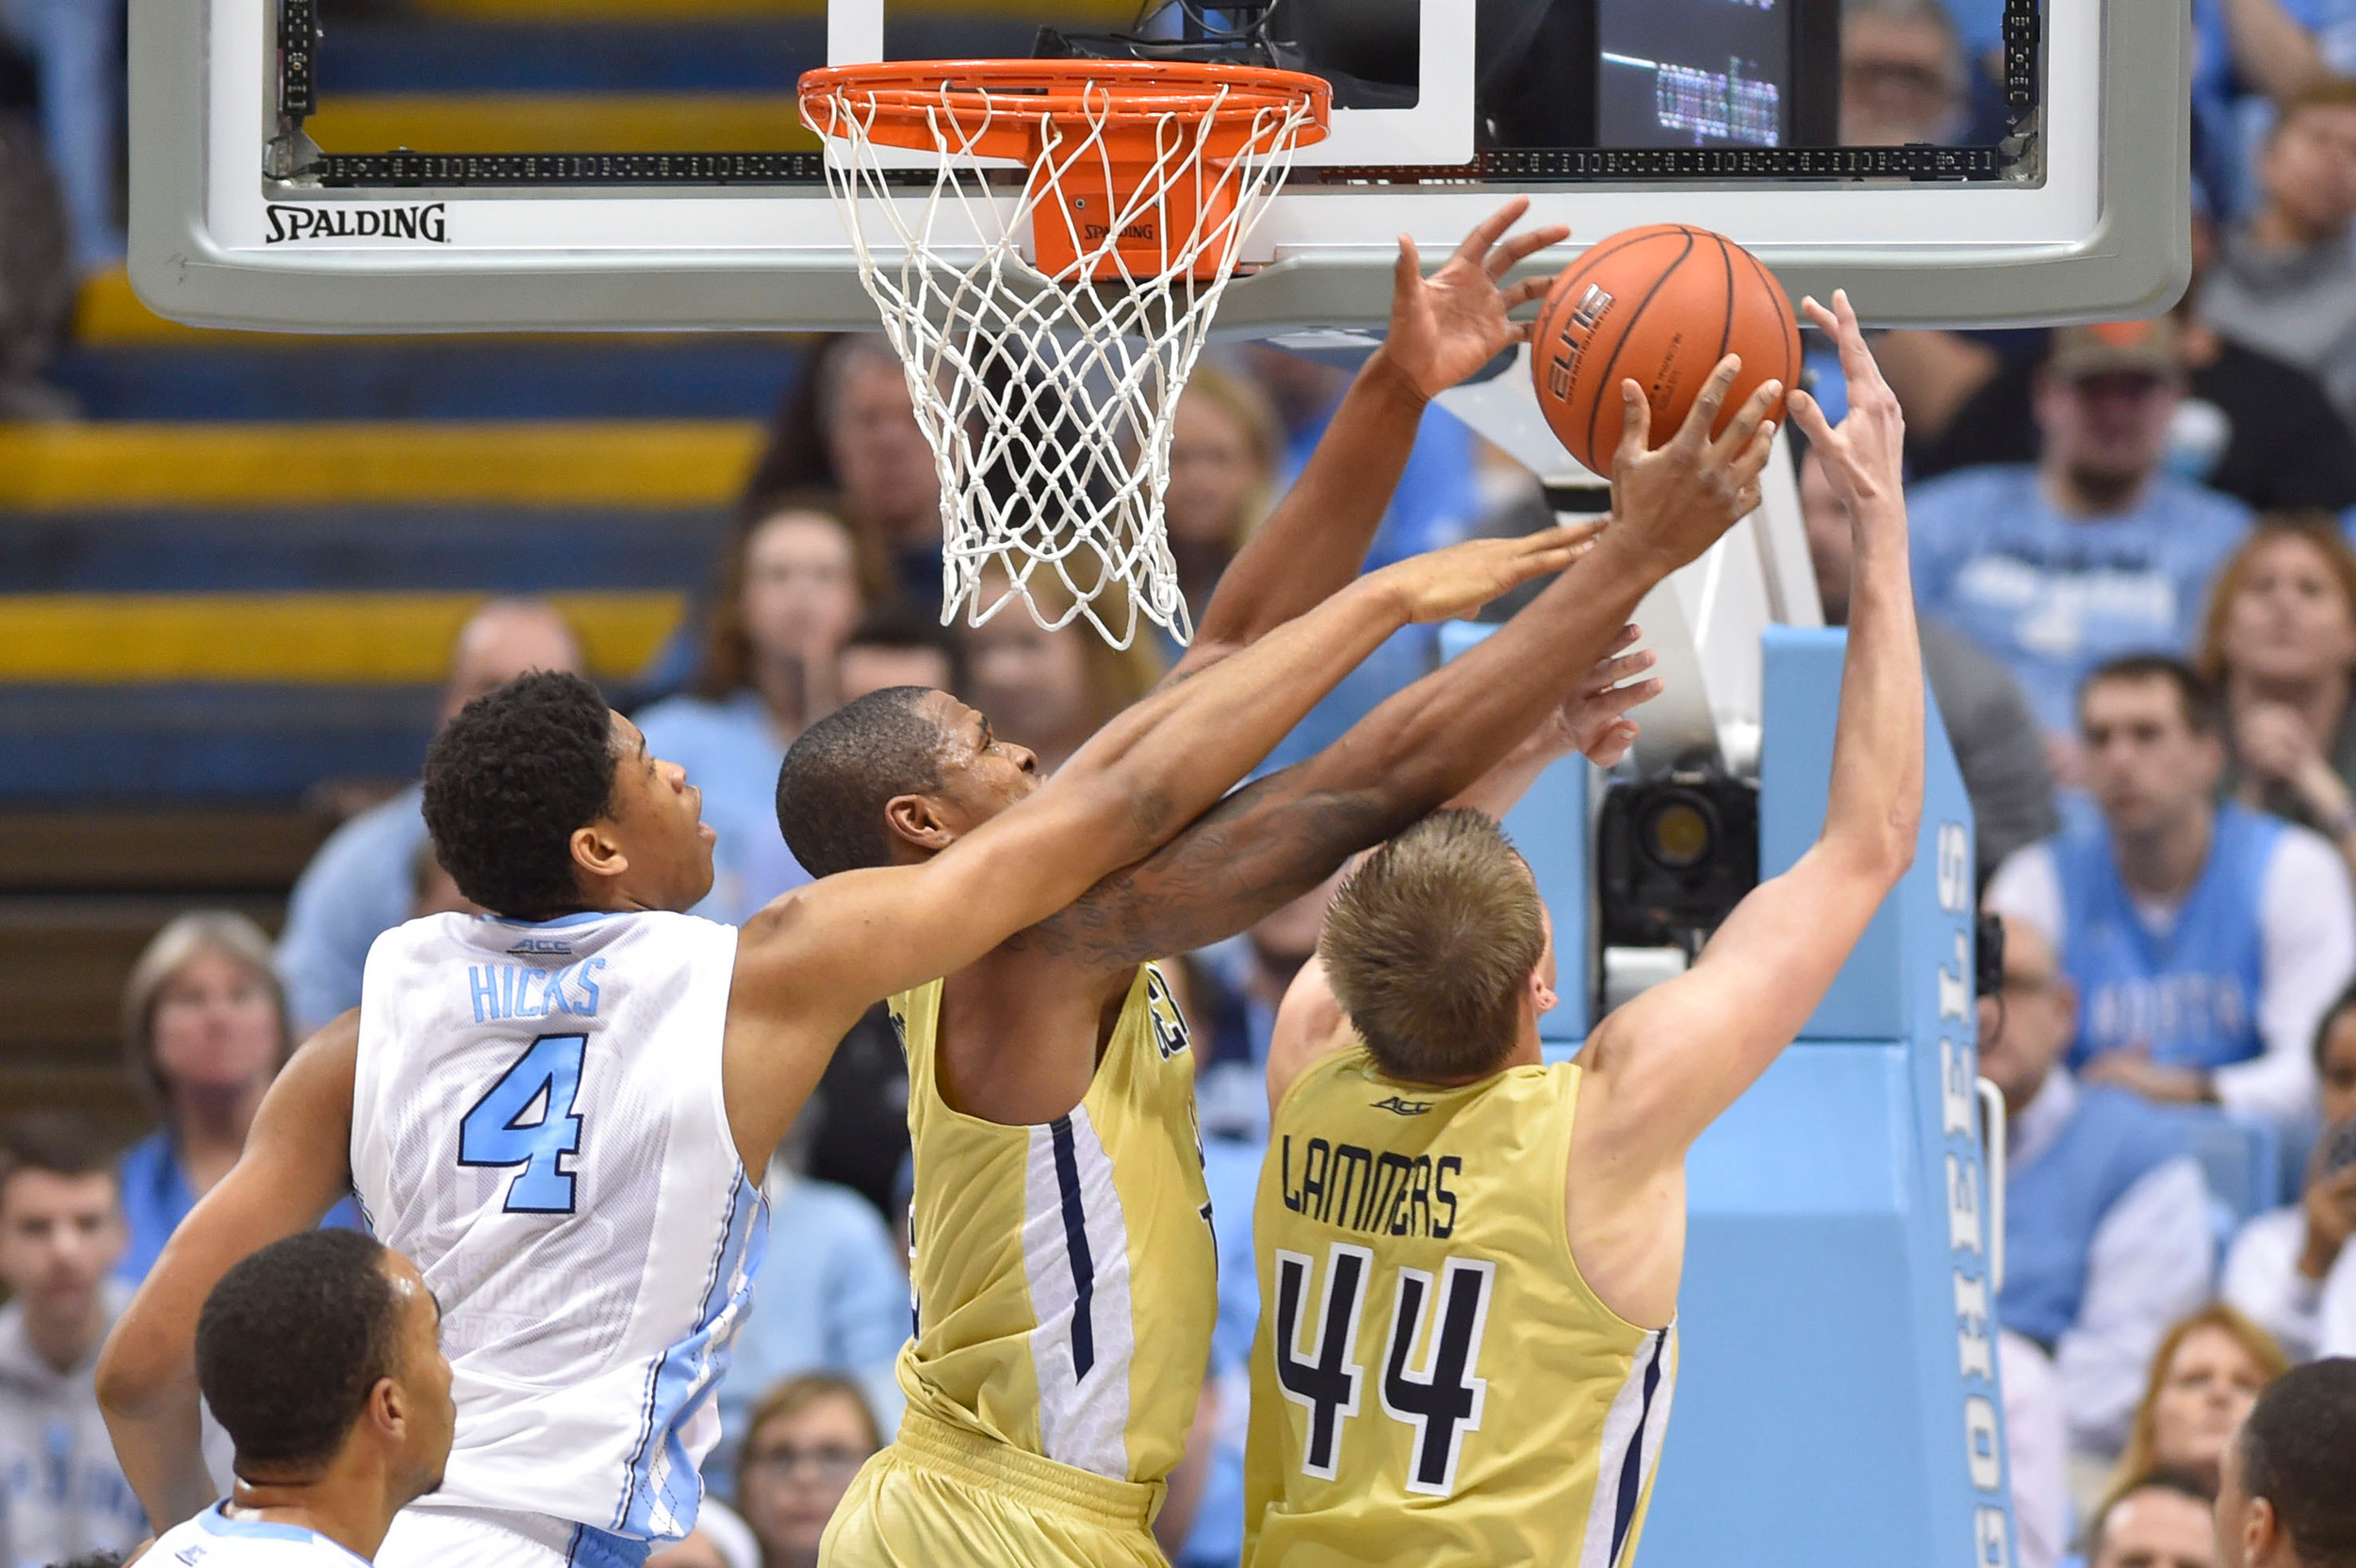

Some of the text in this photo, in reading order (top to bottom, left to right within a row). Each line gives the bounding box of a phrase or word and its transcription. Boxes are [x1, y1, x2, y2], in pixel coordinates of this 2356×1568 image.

[267, 203, 445, 243] SPALDING
[1547, 283, 1612, 403] ELITE
[468, 957, 606, 1022] HICKS
[457, 1033, 589, 1214] 4
[1370, 1096, 1435, 1116] ACC
[1283, 1135, 1463, 1239] LAMMERS
[1274, 1241, 1497, 1498] 44
